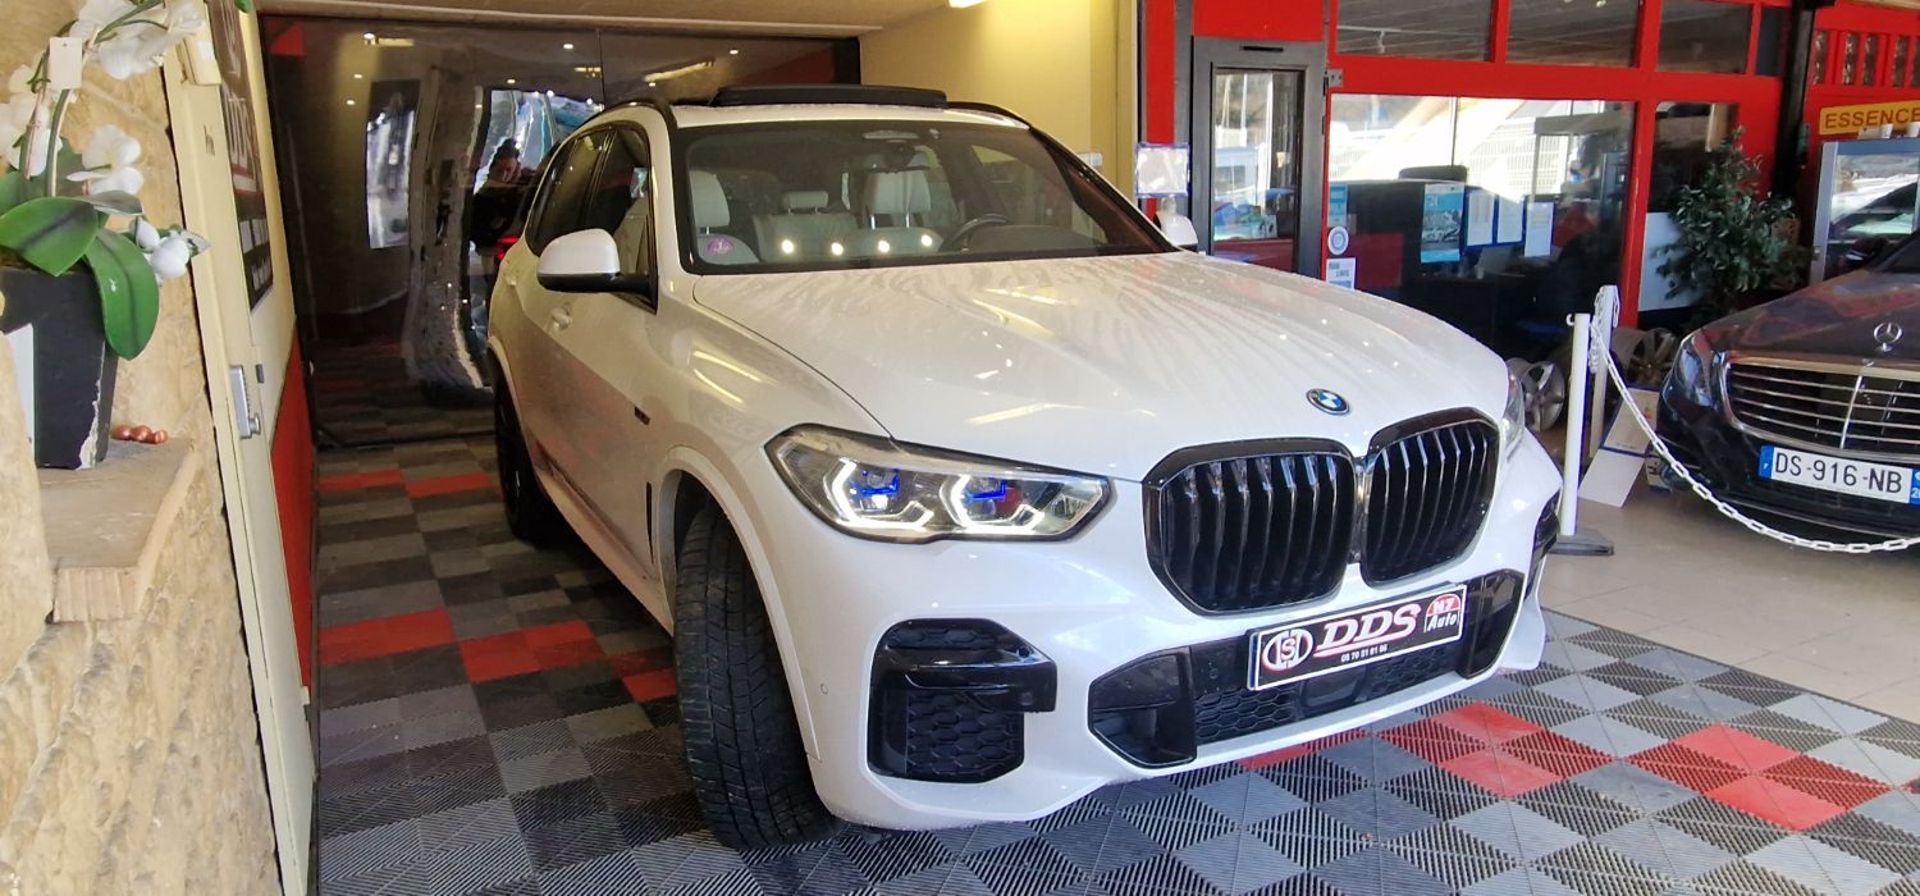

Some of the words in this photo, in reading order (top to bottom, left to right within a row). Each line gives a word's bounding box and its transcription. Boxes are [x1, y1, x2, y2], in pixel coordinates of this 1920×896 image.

[1825, 108, 1920, 128] ESSENCE
[1776, 452, 1902, 493] DS-916-NB
[1313, 603, 1421, 656] DDS
[1427, 612, 1457, 632] Auto
